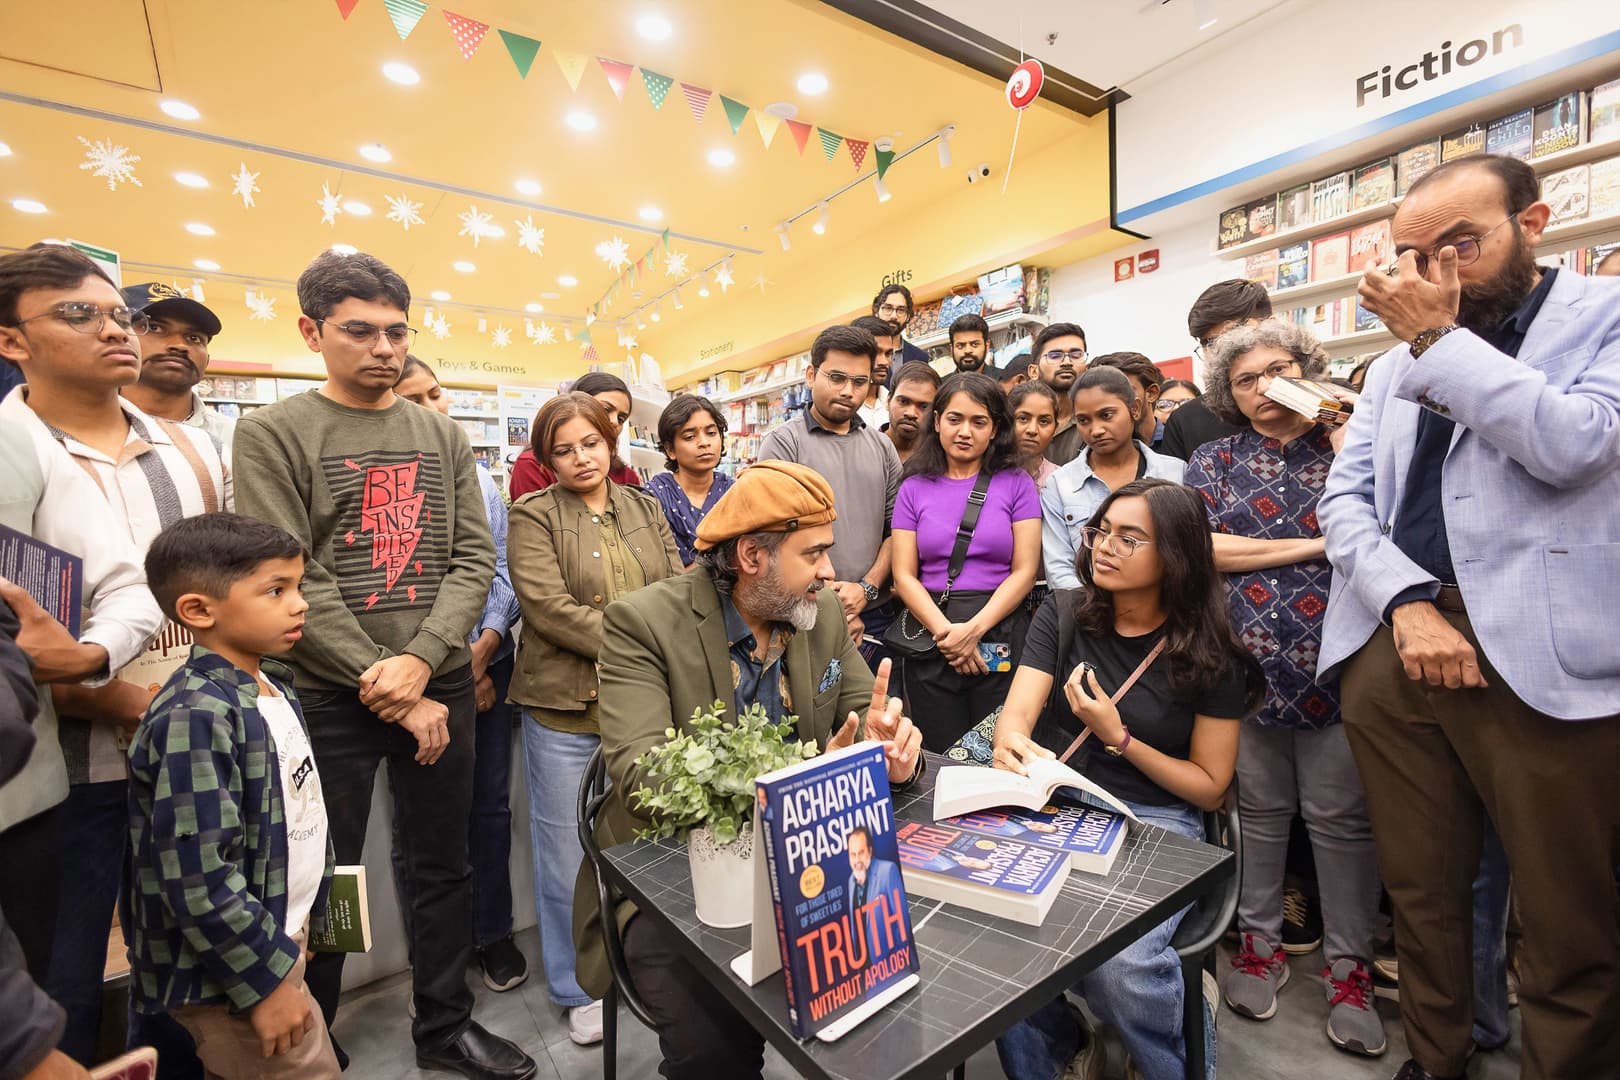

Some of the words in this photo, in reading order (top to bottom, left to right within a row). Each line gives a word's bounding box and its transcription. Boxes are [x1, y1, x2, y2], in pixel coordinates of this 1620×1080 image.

[1356, 23, 1524, 108] Fiction
[1487, 125, 1531, 145] CHILD
[1497, 121, 1521, 134] LEE
[1542, 122, 1572, 138] DEAN
[881, 269, 913, 289] Gifts
[437, 358, 465, 372] Toys
[469, 360, 480, 371] &
[482, 361, 527, 375] Games
[700, 339, 735, 361] Stationery
[366, 466, 418, 510] BE
[782, 766, 876, 834] ACHARYA
[785, 797, 889, 875] PRASHANT
[1038, 804, 1085, 848] PRASHANT
[1069, 808, 1113, 847] ACHARYA
[898, 826, 963, 867] TRUTH
[968, 840, 1026, 886] PRASHANT
[1001, 846, 1055, 886] ACHARYA
[795, 902, 808, 916] FOR
[829, 898, 842, 915] LIES
[796, 887, 908, 993] TRUTH
[809, 974, 862, 1022] WITHOUT
[865, 946, 911, 991] APOLOGY
